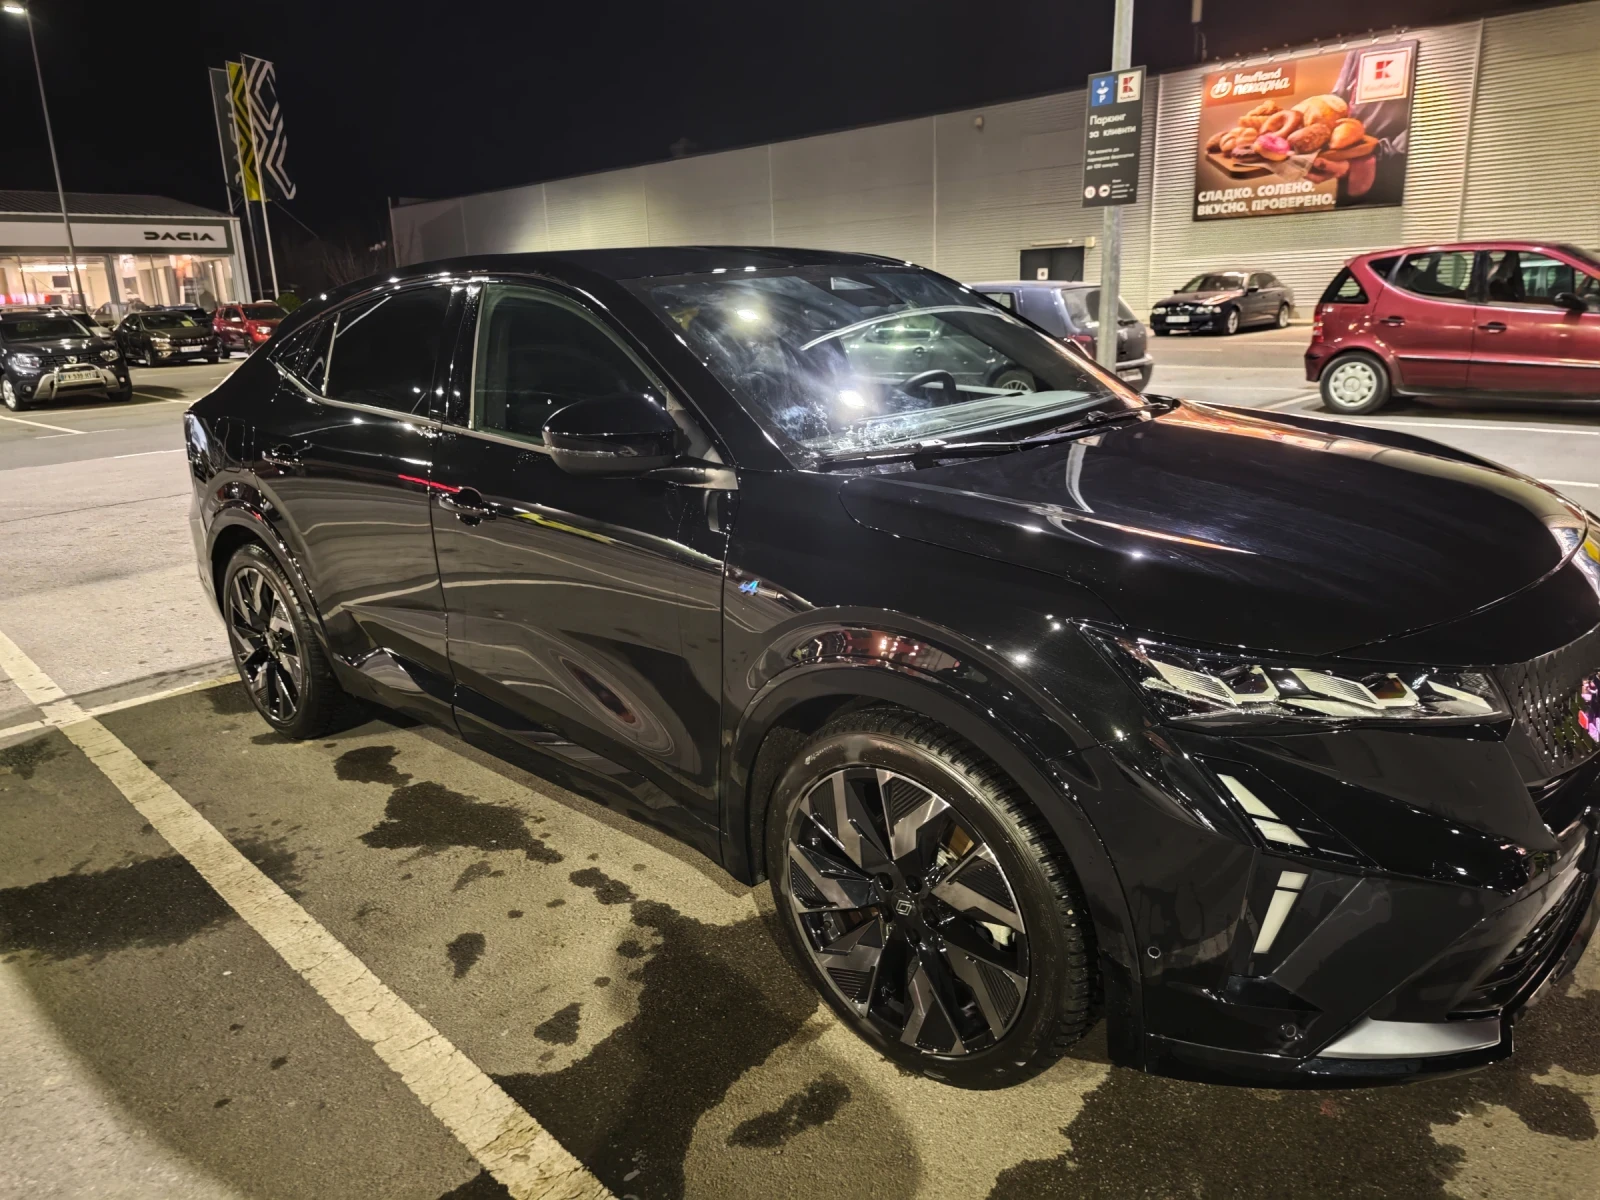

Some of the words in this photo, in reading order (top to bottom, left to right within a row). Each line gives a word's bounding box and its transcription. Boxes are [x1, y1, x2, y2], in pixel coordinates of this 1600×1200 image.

[1234, 68, 1282, 84] Kaufland
[1090, 113, 1127, 126] Паркинг
[1198, 187, 1255, 202] СЛАДКО.
[1257, 181, 1316, 197] СОЛЕНО.
[1197, 201, 1249, 216] ВКУСНО.
[1251, 193, 1336, 211] ПРОВЕРЕНО.
[143, 231, 216, 242] DACIA
